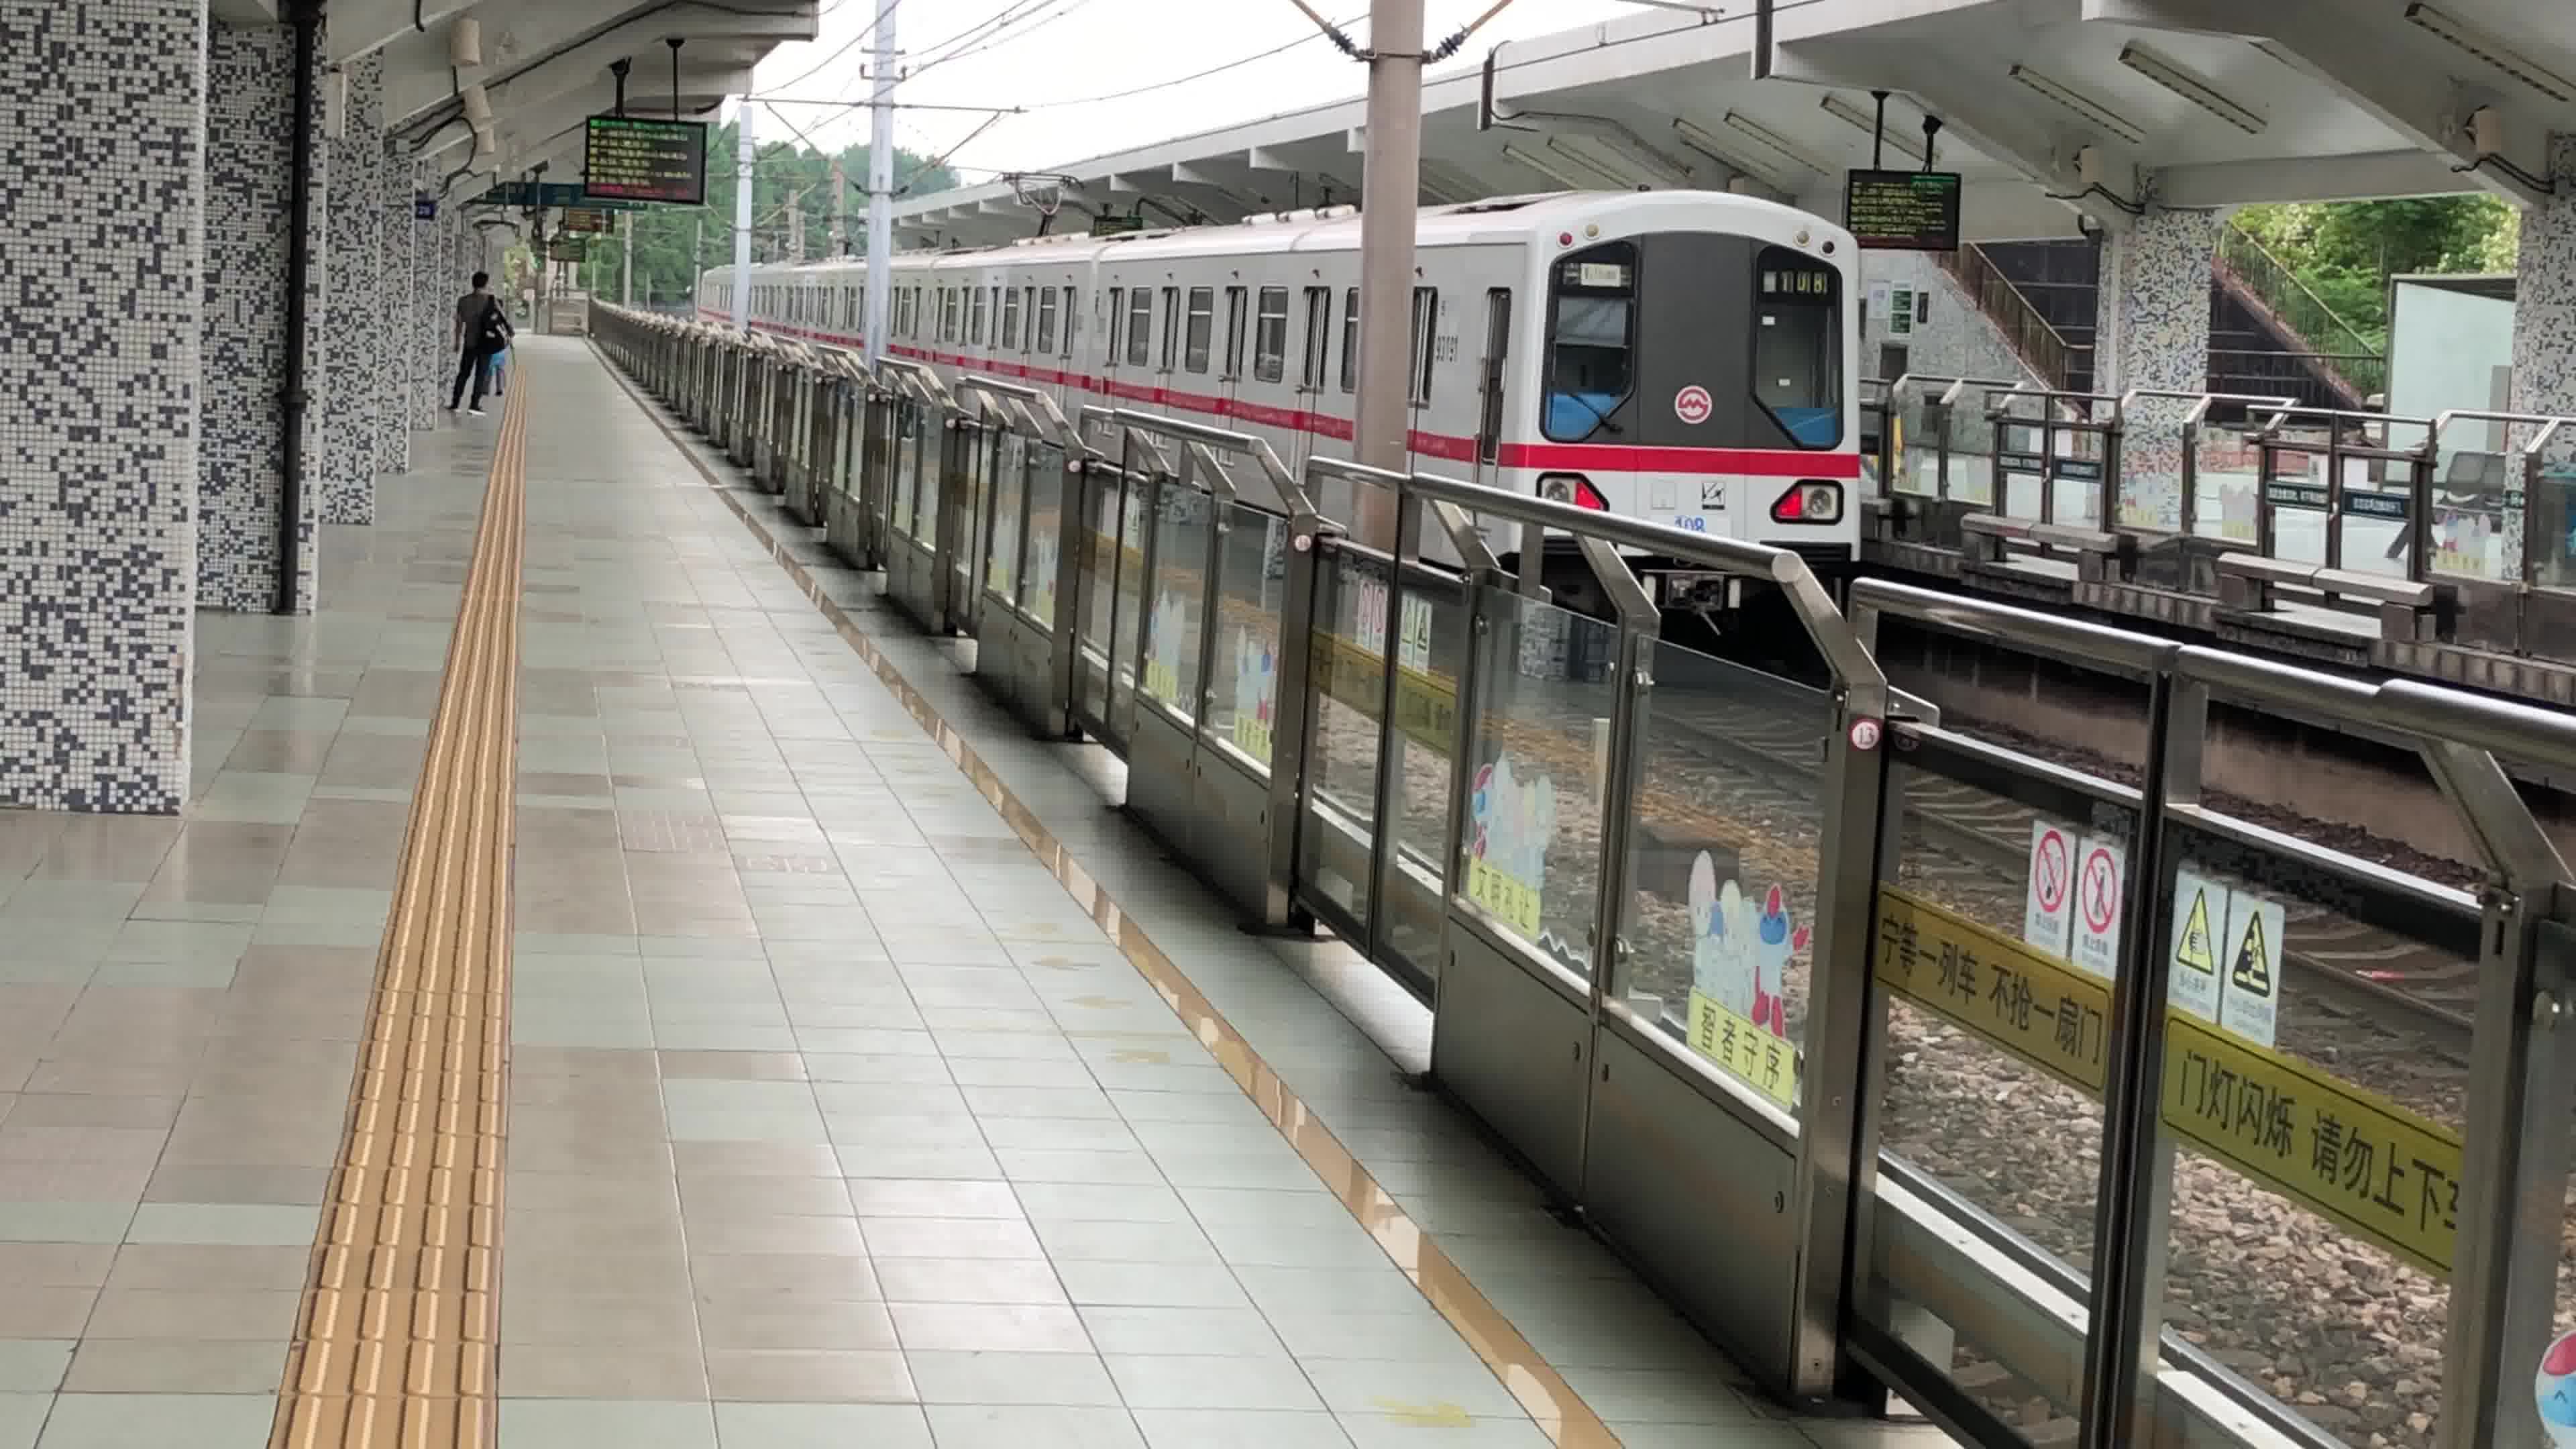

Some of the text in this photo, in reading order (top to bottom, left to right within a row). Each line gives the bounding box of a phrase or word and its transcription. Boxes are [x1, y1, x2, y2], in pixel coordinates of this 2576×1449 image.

[1881, 912, 2103, 1065] 宁等一列车 不抢一扇门
[2179, 1050, 2296, 1159] 门灯闪烁
